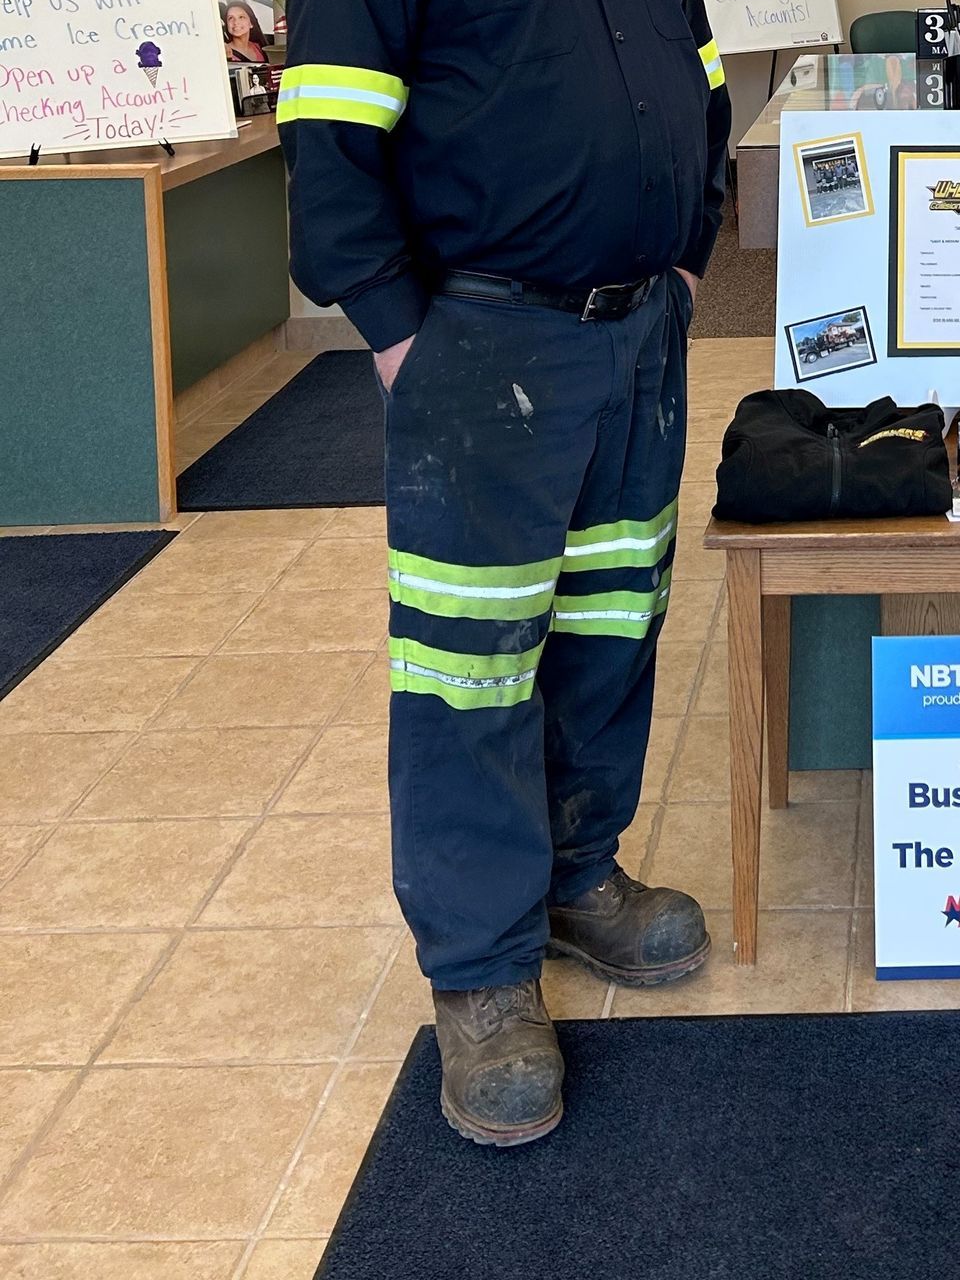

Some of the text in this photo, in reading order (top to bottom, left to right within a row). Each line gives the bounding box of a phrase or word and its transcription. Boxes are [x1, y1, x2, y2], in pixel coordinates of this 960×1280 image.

[67, 22, 100, 45] Ice
[114, 11, 200, 41] Cream!
[924, 14, 945, 43] 3
[931, 47, 948, 55] MA
[67, 65, 95, 85] up
[112, 59, 127, 74] a
[0, 77, 189, 125] hecking Account!
[86, 109, 165, 139] Today!
[892, 841, 953, 868] The
